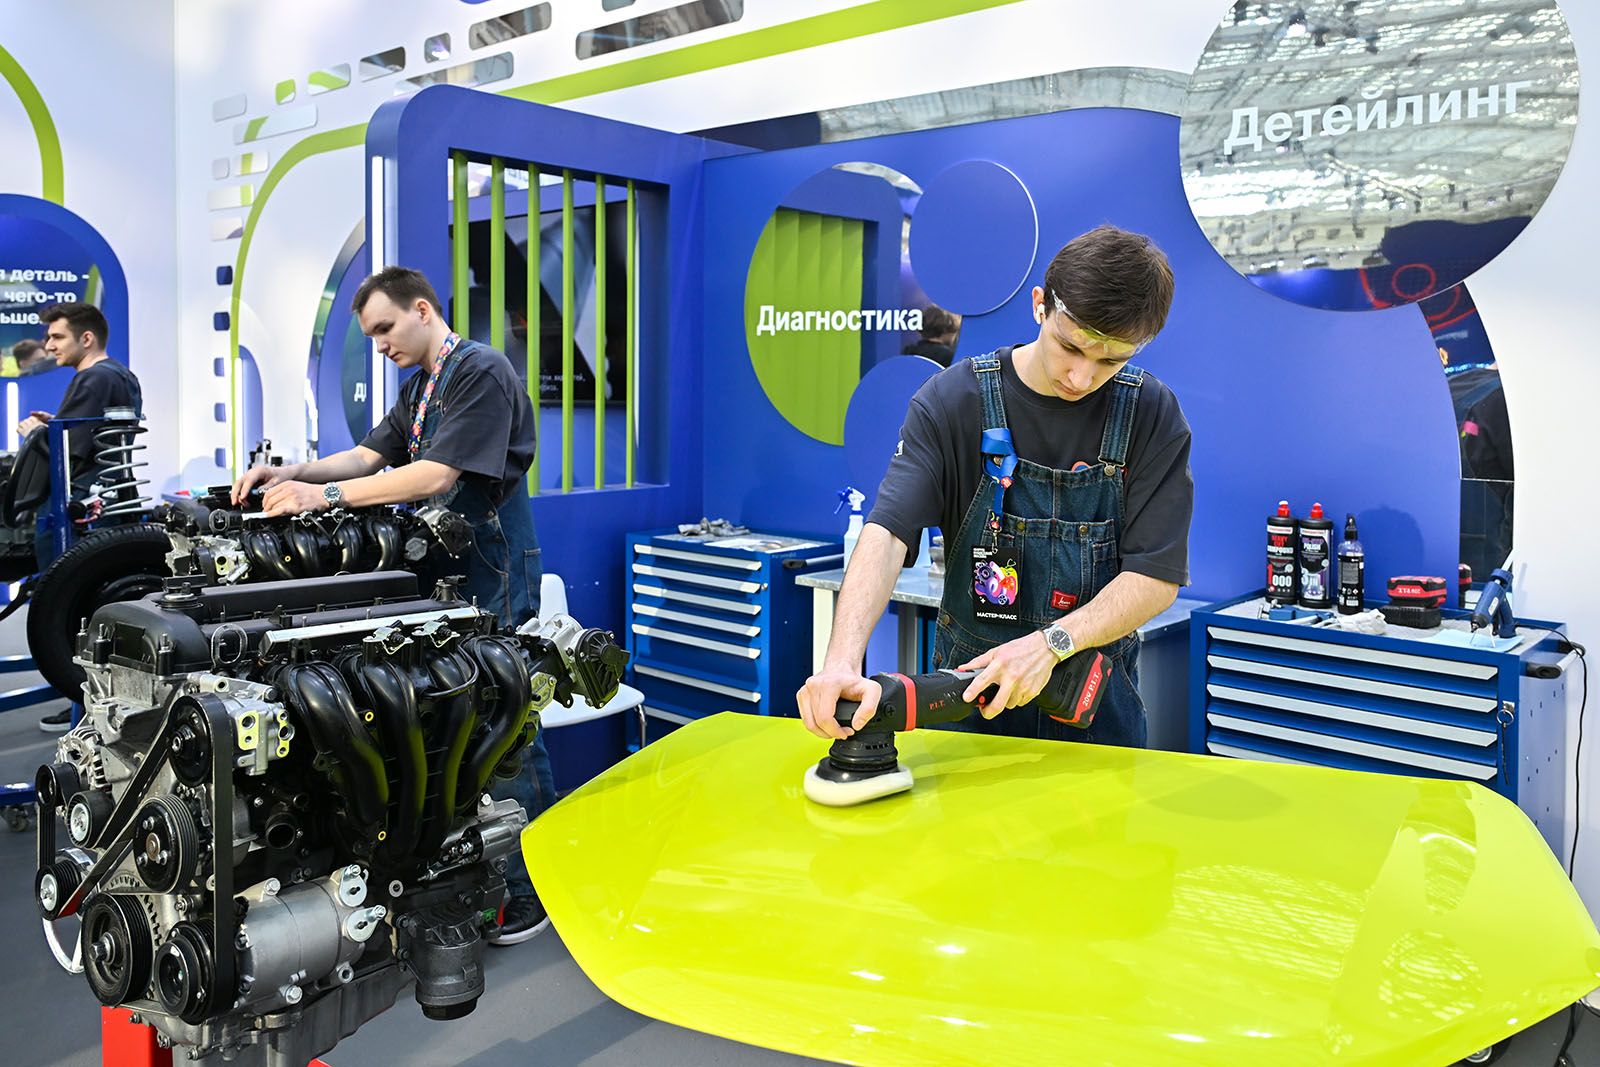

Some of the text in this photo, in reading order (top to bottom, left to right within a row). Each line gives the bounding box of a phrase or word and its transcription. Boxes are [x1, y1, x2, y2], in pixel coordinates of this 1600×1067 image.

[1223, 80, 1533, 155] Детейлинг
[10, 268, 78, 283] деталь
[4, 291, 77, 303] чего-то
[756, 305, 923, 336] Диагностика
[976, 612, 1017, 620] МАСТЕР-КЛАСС
